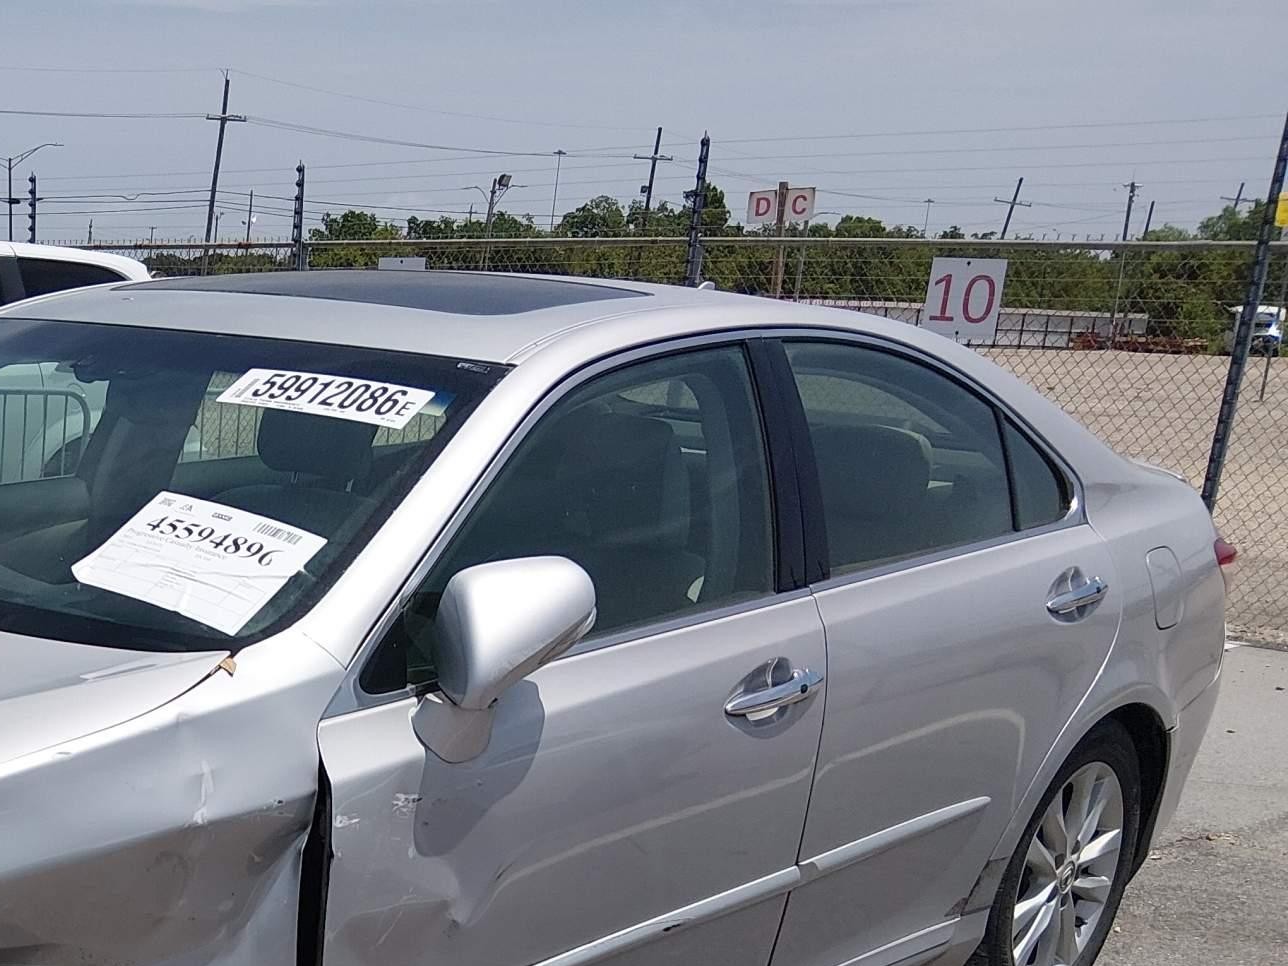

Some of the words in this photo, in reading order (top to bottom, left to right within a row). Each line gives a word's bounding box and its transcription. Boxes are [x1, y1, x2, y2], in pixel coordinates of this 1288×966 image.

[755, 197, 771, 217] D
[792, 195, 808, 215] C
[929, 273, 996, 324] 10
[147, 515, 285, 567] 45594896
